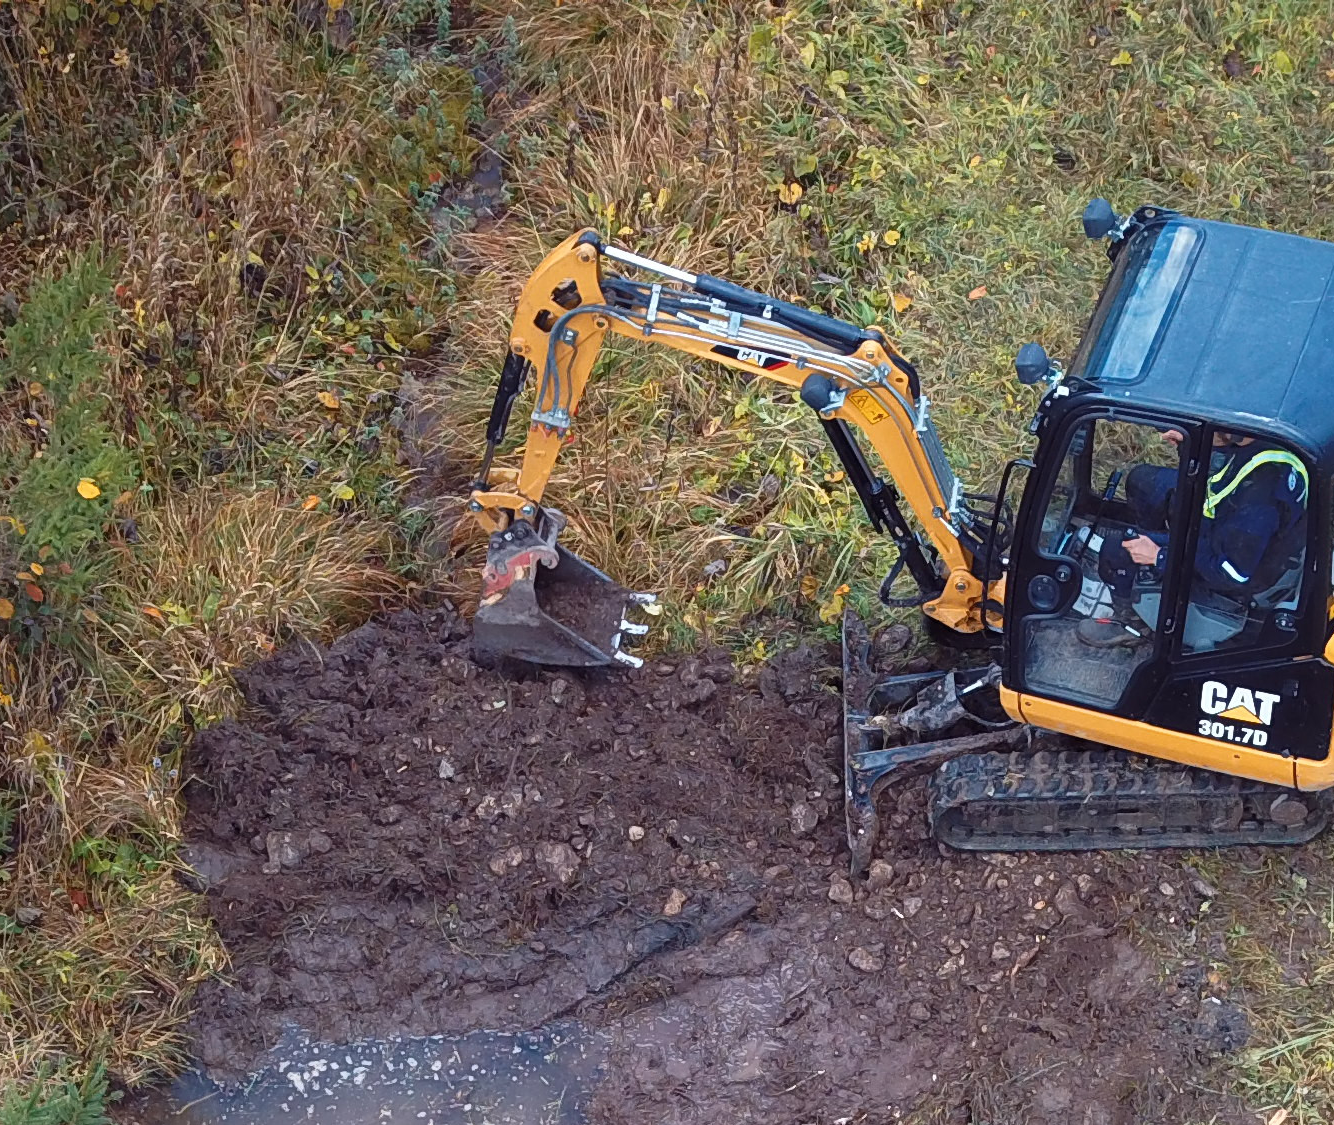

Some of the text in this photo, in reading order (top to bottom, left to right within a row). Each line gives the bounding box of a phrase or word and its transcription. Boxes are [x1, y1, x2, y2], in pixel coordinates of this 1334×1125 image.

[737, 349, 767, 367] CAT
[1201, 681, 1280, 725] CAT
[1198, 720, 1268, 746] 301.7D
